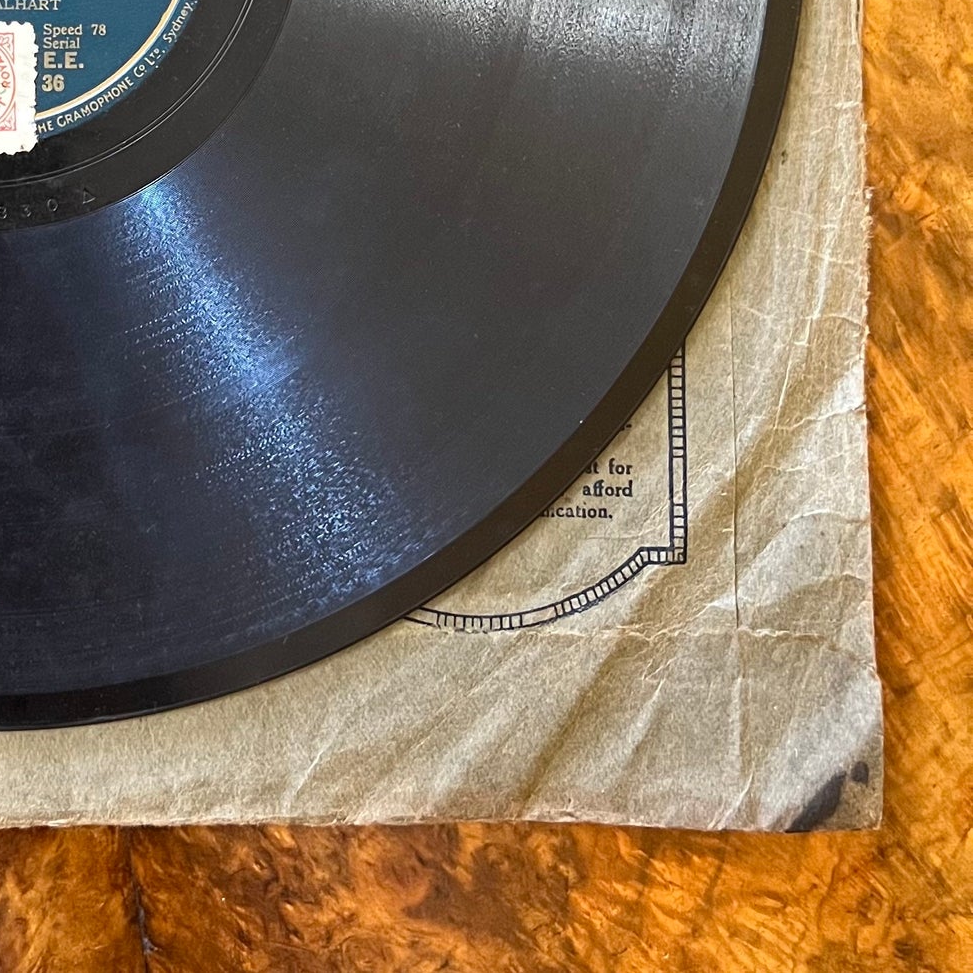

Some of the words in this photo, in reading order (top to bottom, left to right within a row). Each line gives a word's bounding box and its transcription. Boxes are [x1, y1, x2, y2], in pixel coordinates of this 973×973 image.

[43, 24, 83, 37] Speed
[91, 24, 106, 36] 78
[43, 37, 80, 49] Serial
[43, 52, 85, 69] E.E.
[41, 74, 65, 92] 36
[36, 120, 54, 134] HE
[56, 76, 135, 128] GRAMOPHONE
[608, 458, 633, 475] for
[582, 479, 633, 497] afford
